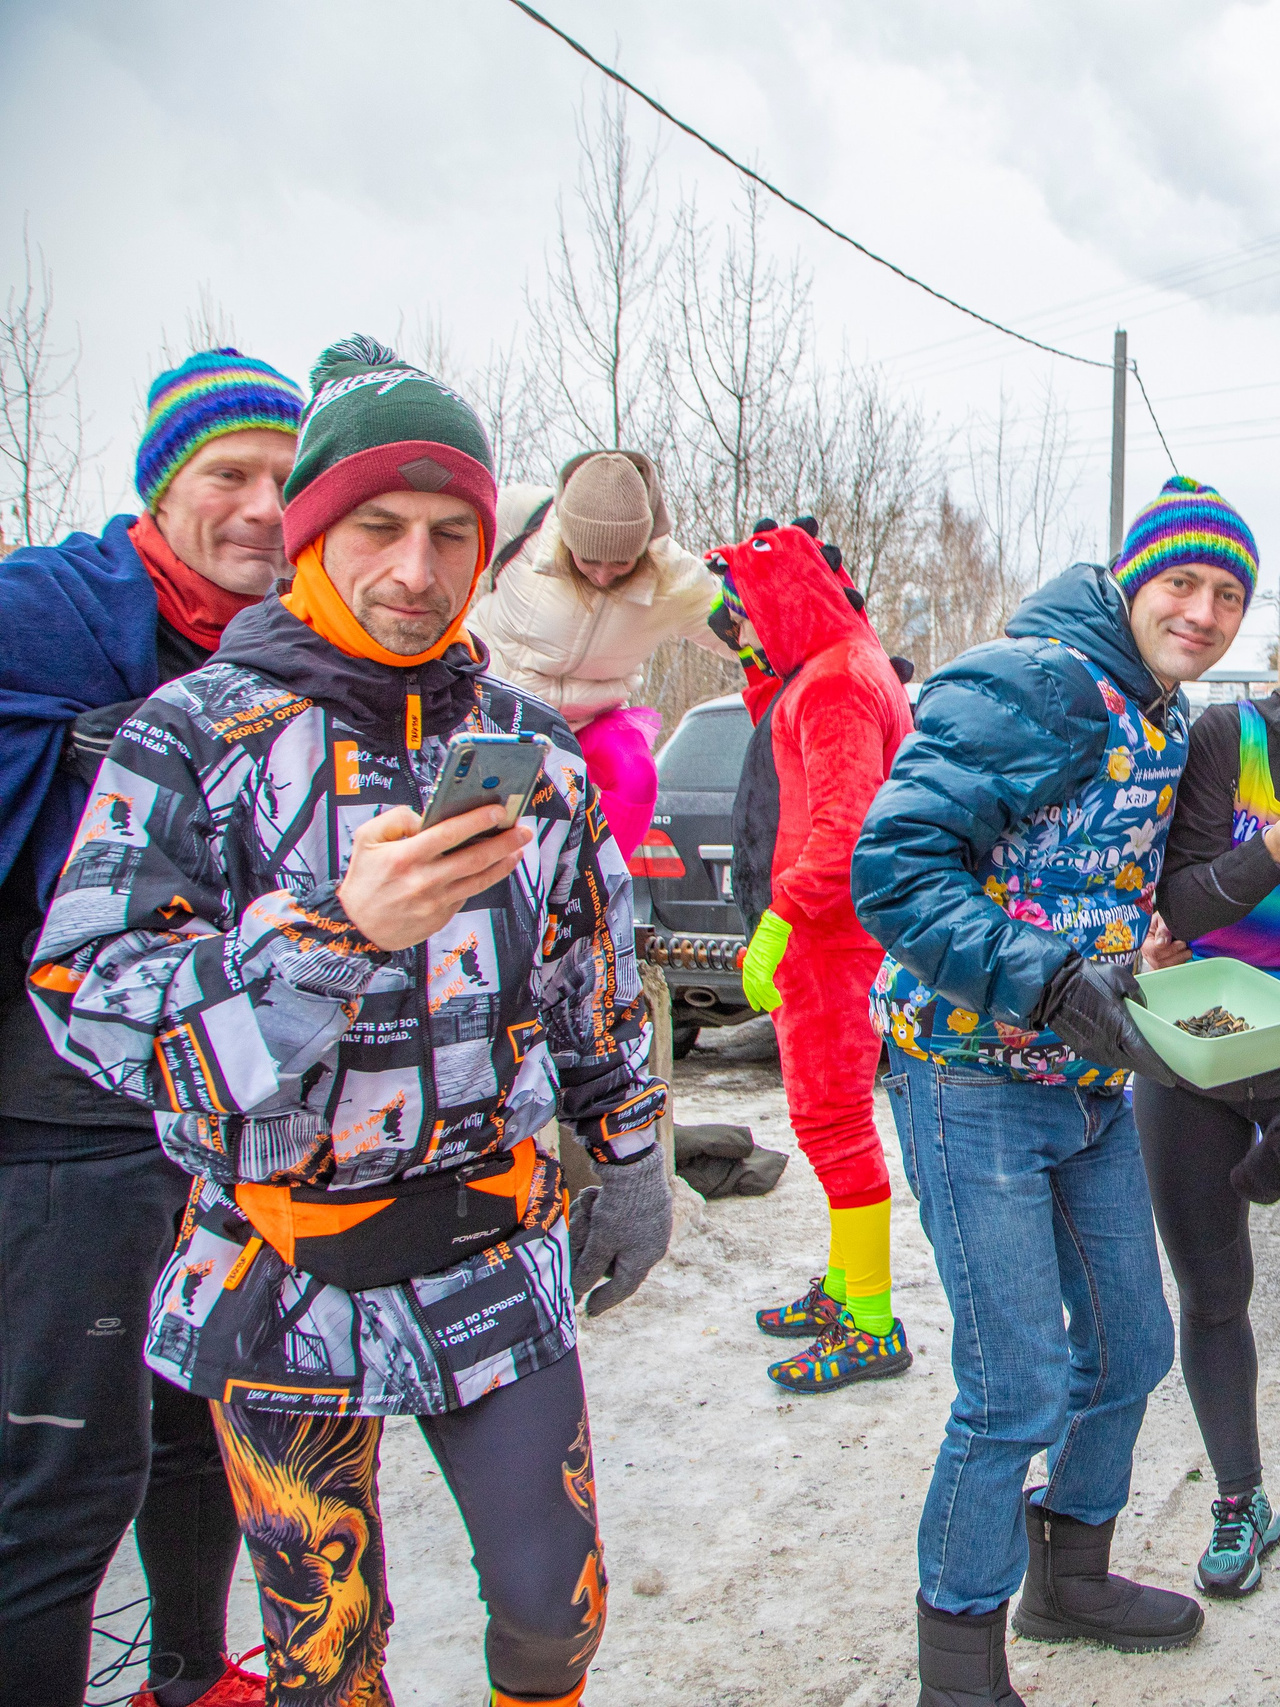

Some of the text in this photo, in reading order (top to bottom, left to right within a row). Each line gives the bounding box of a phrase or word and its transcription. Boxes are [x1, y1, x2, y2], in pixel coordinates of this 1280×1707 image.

[274, 697, 314, 721] OPINIO
[1126, 793, 1148, 804] KRB
[452, 1228, 501, 1244] POWERUP
[444, 1320, 466, 1336] ARE
[464, 1312, 482, 1326] NO
[449, 1331, 470, 1346] OUR
